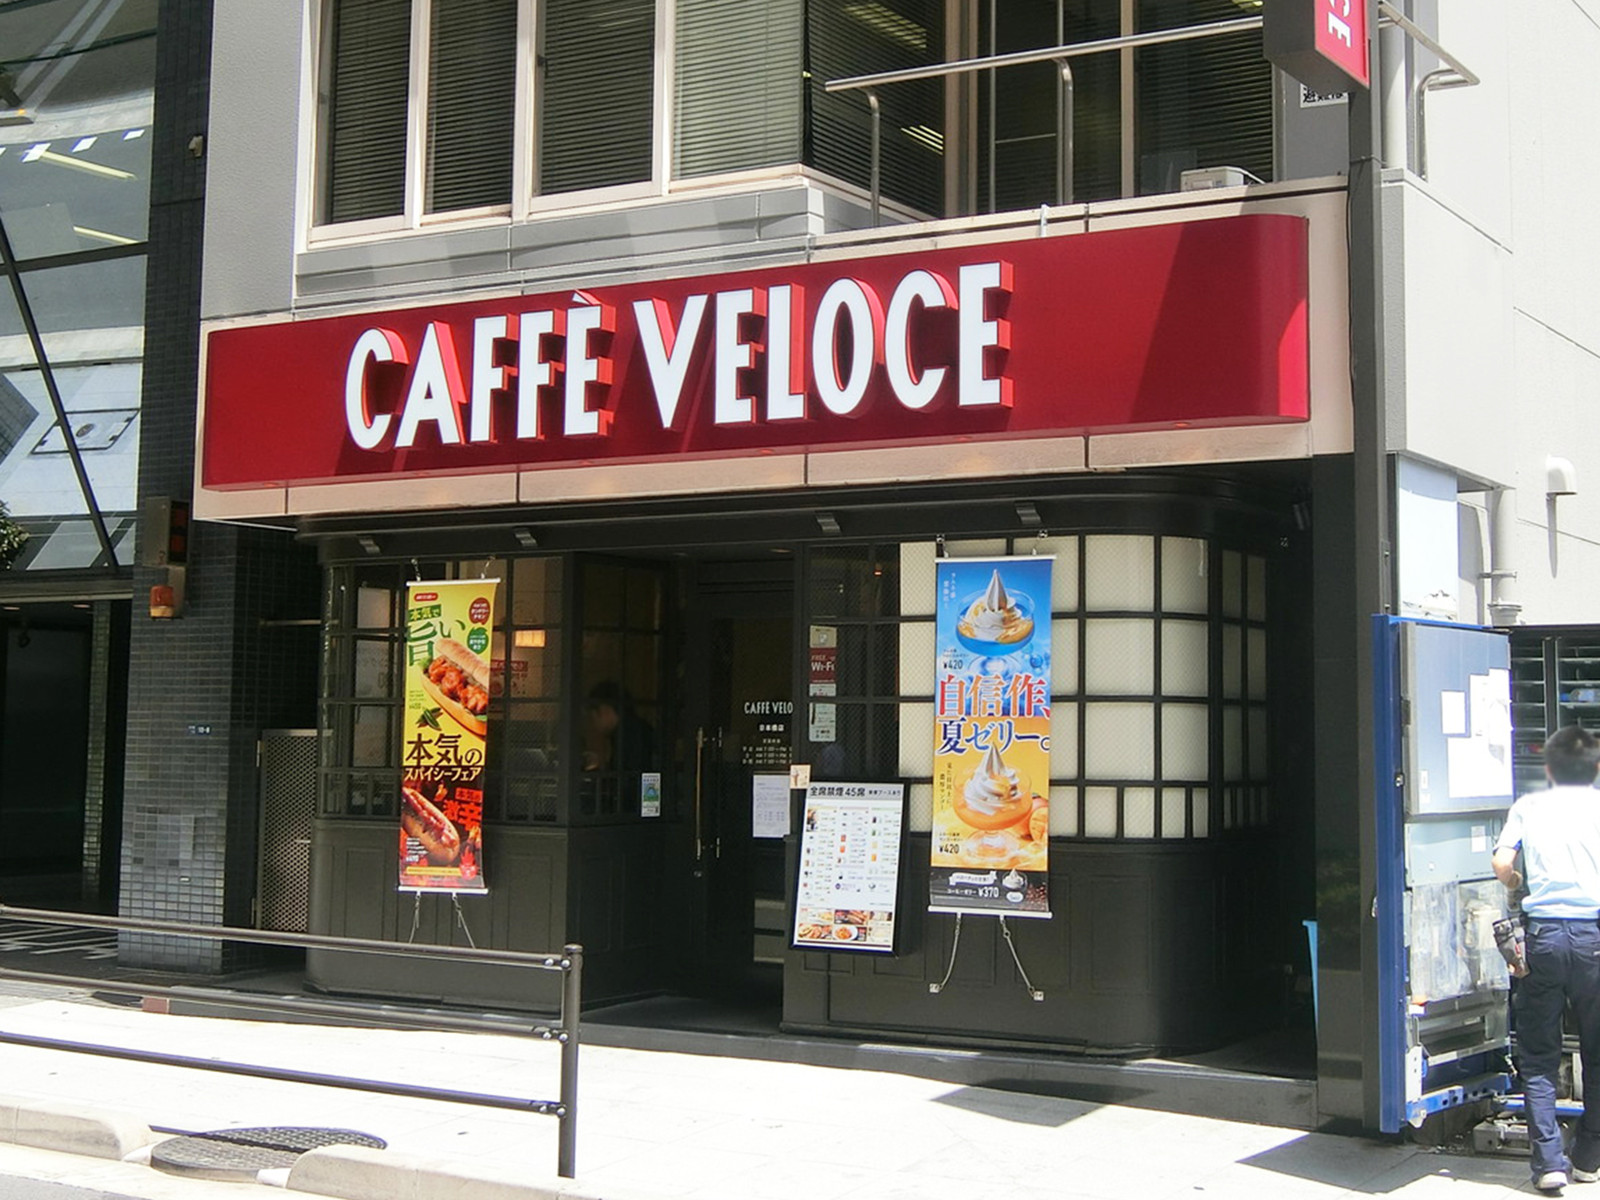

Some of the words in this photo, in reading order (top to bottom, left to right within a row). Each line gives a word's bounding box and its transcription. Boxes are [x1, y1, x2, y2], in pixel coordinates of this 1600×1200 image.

[345, 290, 610, 450] CAFFÈ
[633, 261, 1008, 430] VELOCE
[811, 662, 835, 672] Wi-Fi
[943, 659, 963, 670] ¥420
[405, 733, 482, 766] 本気の
[404, 767, 481, 781] スパイシーフェア
[938, 843, 960, 855] ¥420
[978, 886, 999, 898] ¥370
